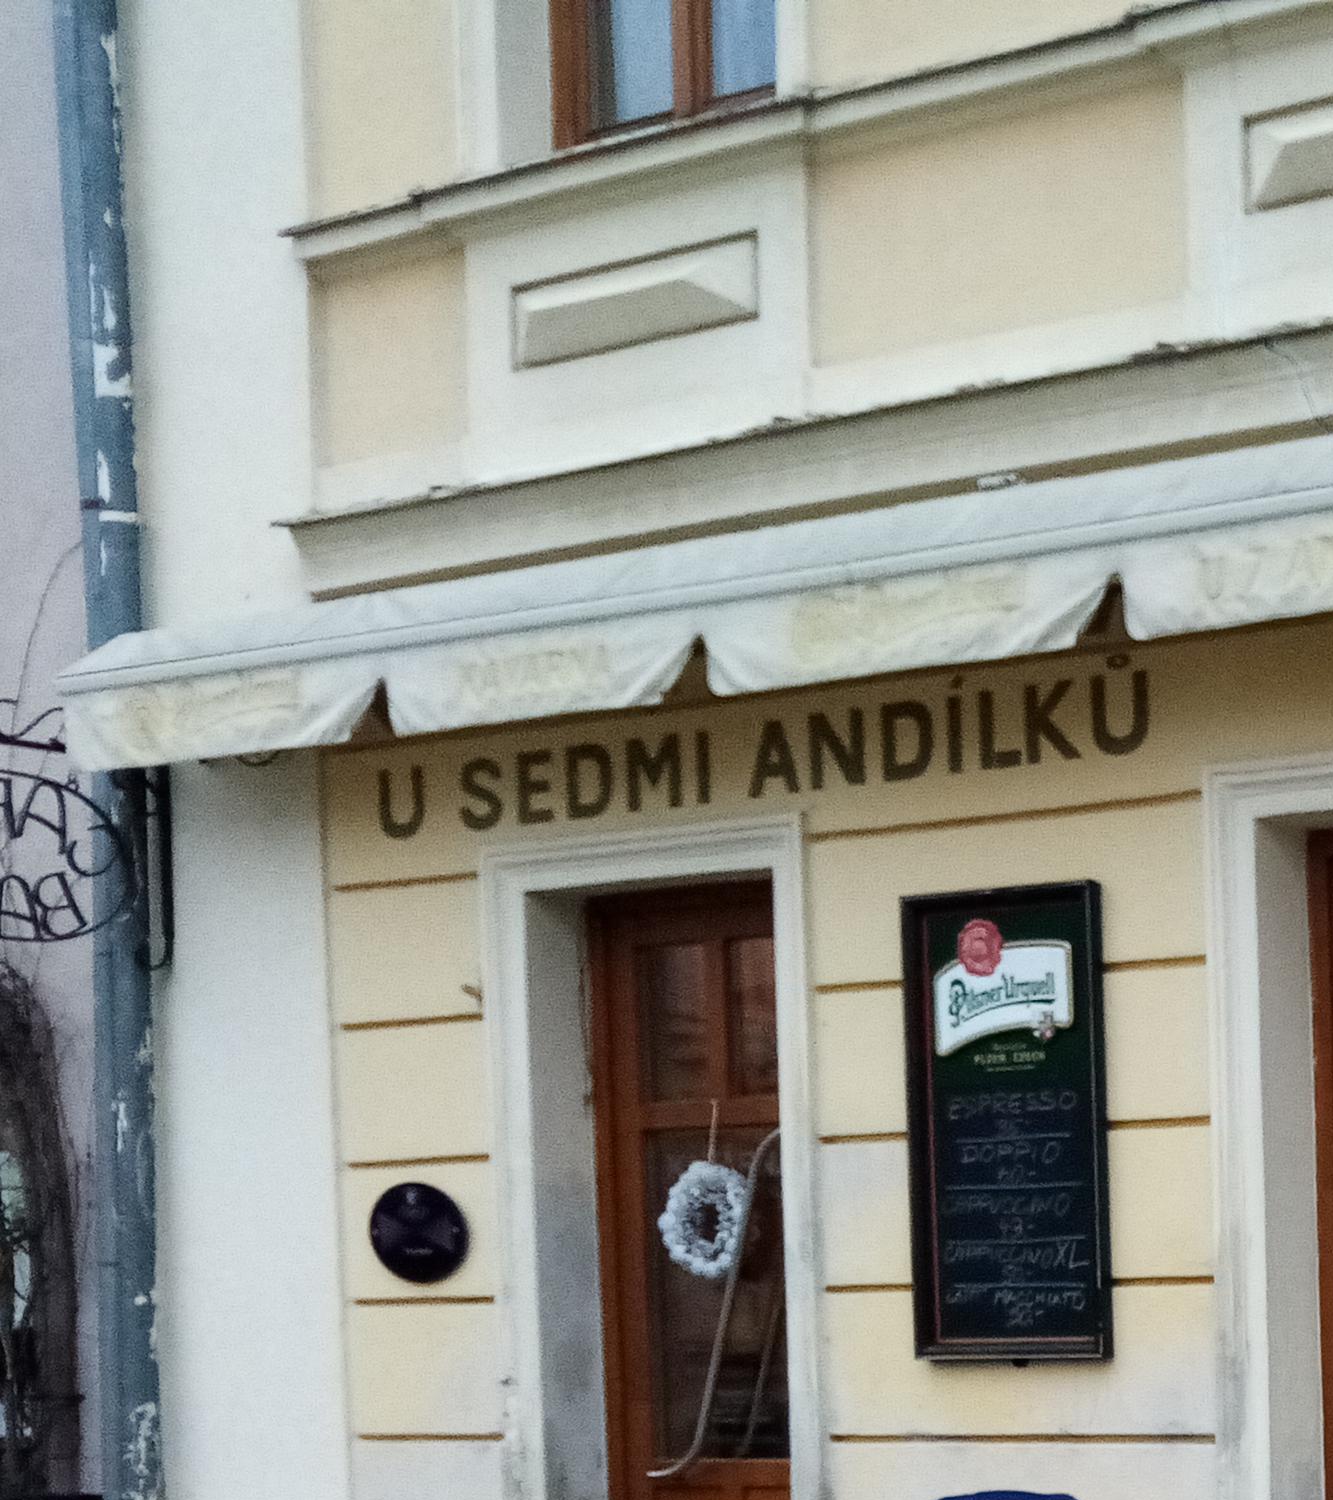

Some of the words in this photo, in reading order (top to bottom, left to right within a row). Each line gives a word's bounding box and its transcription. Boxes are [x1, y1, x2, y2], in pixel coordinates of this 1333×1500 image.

[376, 768, 426, 840] U
[458, 729, 711, 832] SEDMI
[747, 652, 1150, 799] ANDÍLKŮ
[960, 1140, 1062, 1164] DOPPIO
